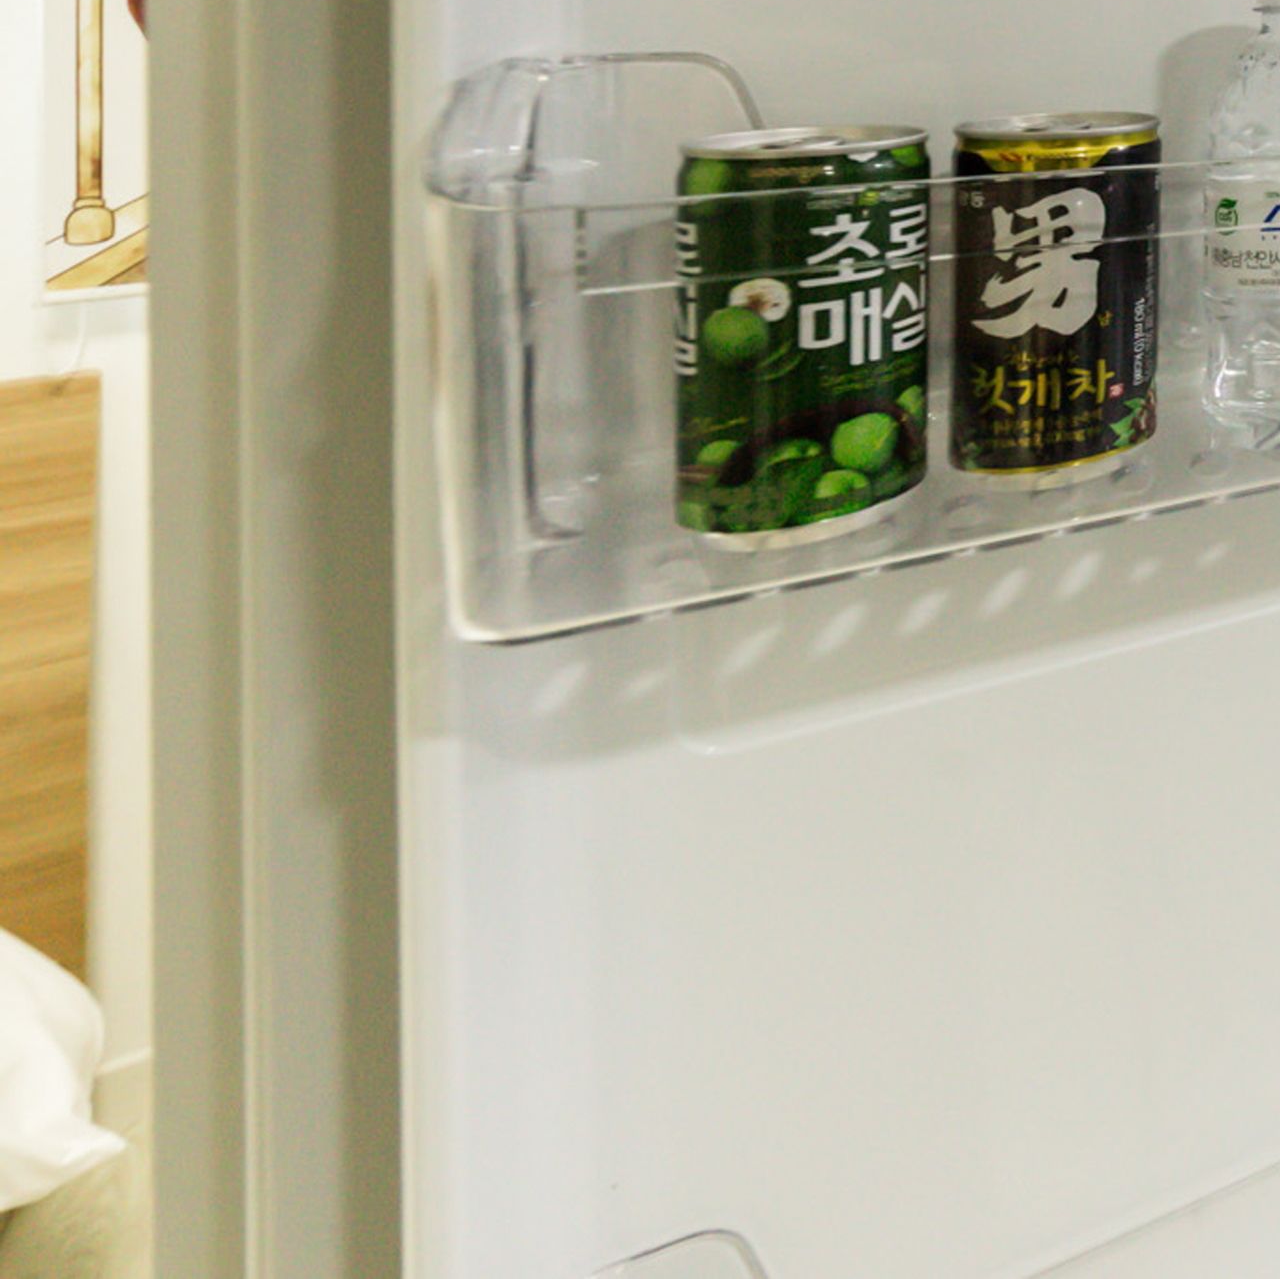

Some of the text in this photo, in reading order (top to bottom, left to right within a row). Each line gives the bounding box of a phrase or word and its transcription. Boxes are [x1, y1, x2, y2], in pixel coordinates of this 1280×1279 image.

[797, 203, 928, 288] 초록
[970, 187, 1107, 339] 男
[798, 278, 927, 366] 매실
[971, 358, 1116, 415] 헛개차
